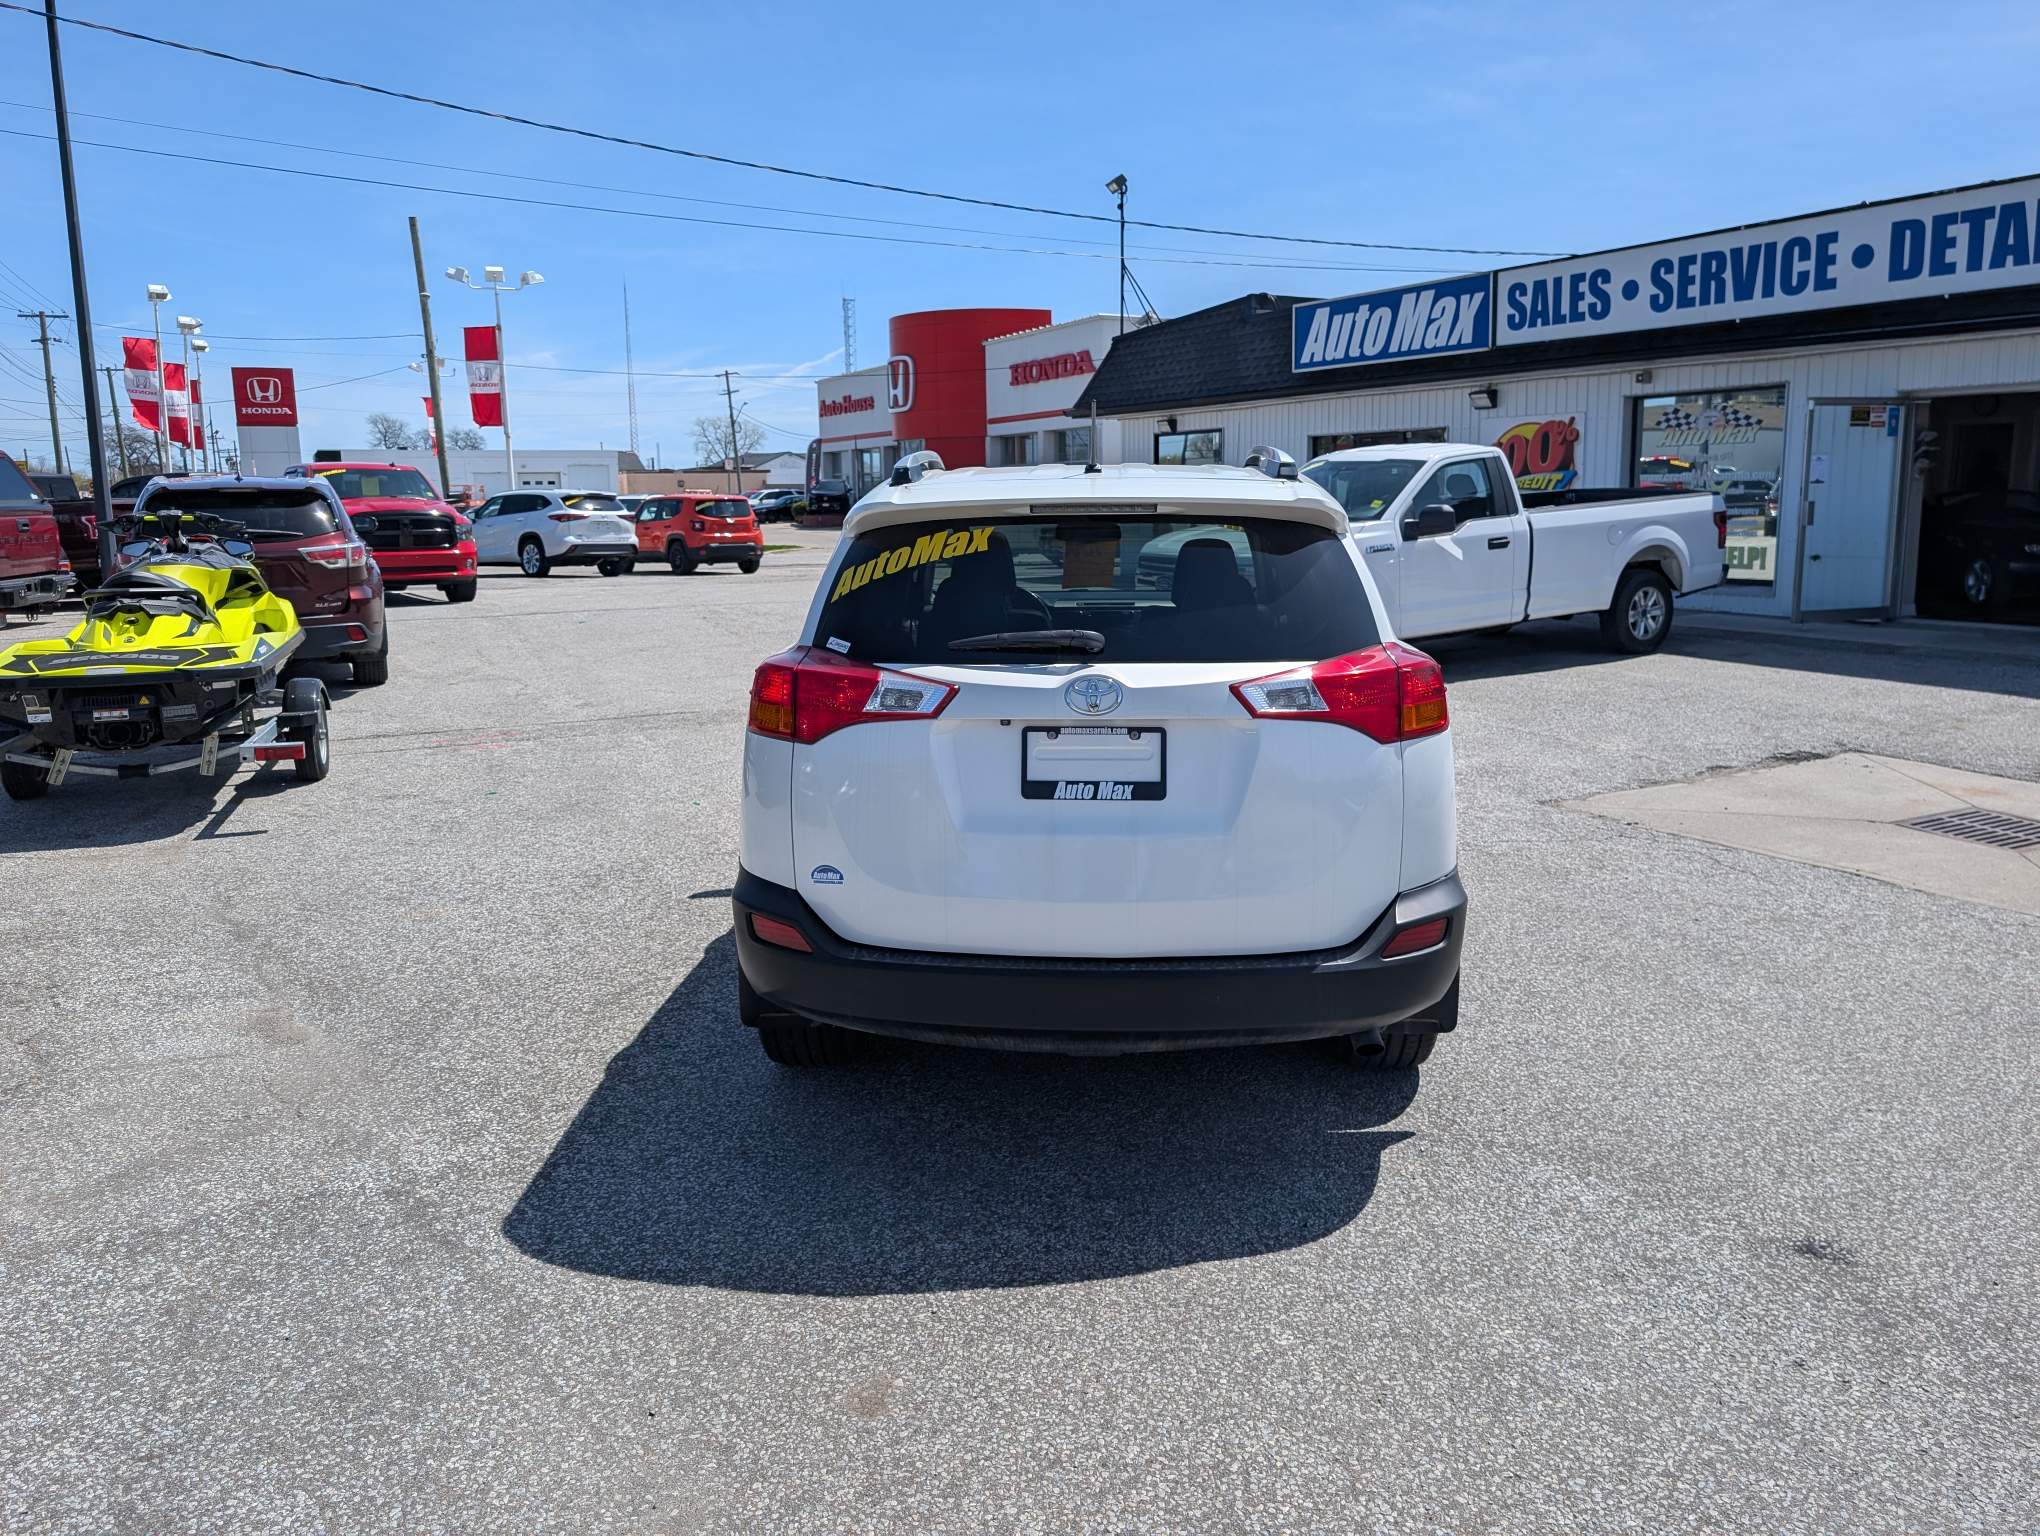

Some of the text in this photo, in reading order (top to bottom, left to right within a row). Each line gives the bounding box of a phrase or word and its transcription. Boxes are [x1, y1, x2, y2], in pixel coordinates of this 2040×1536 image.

[1507, 268, 1611, 331] SALES
[1650, 231, 1839, 313] SERVICE
[1009, 350, 1096, 386] HONDA
[241, 407, 292, 415] HONDA
[1499, 416, 1580, 478] 00%
[1516, 473, 1564, 492] REDIT
[831, 526, 993, 604] AutoMax
[1726, 546, 1768, 571] ELP!
[1060, 727, 1128, 735] automaxsarnia.com
[1054, 781, 1134, 800] Auto Max
